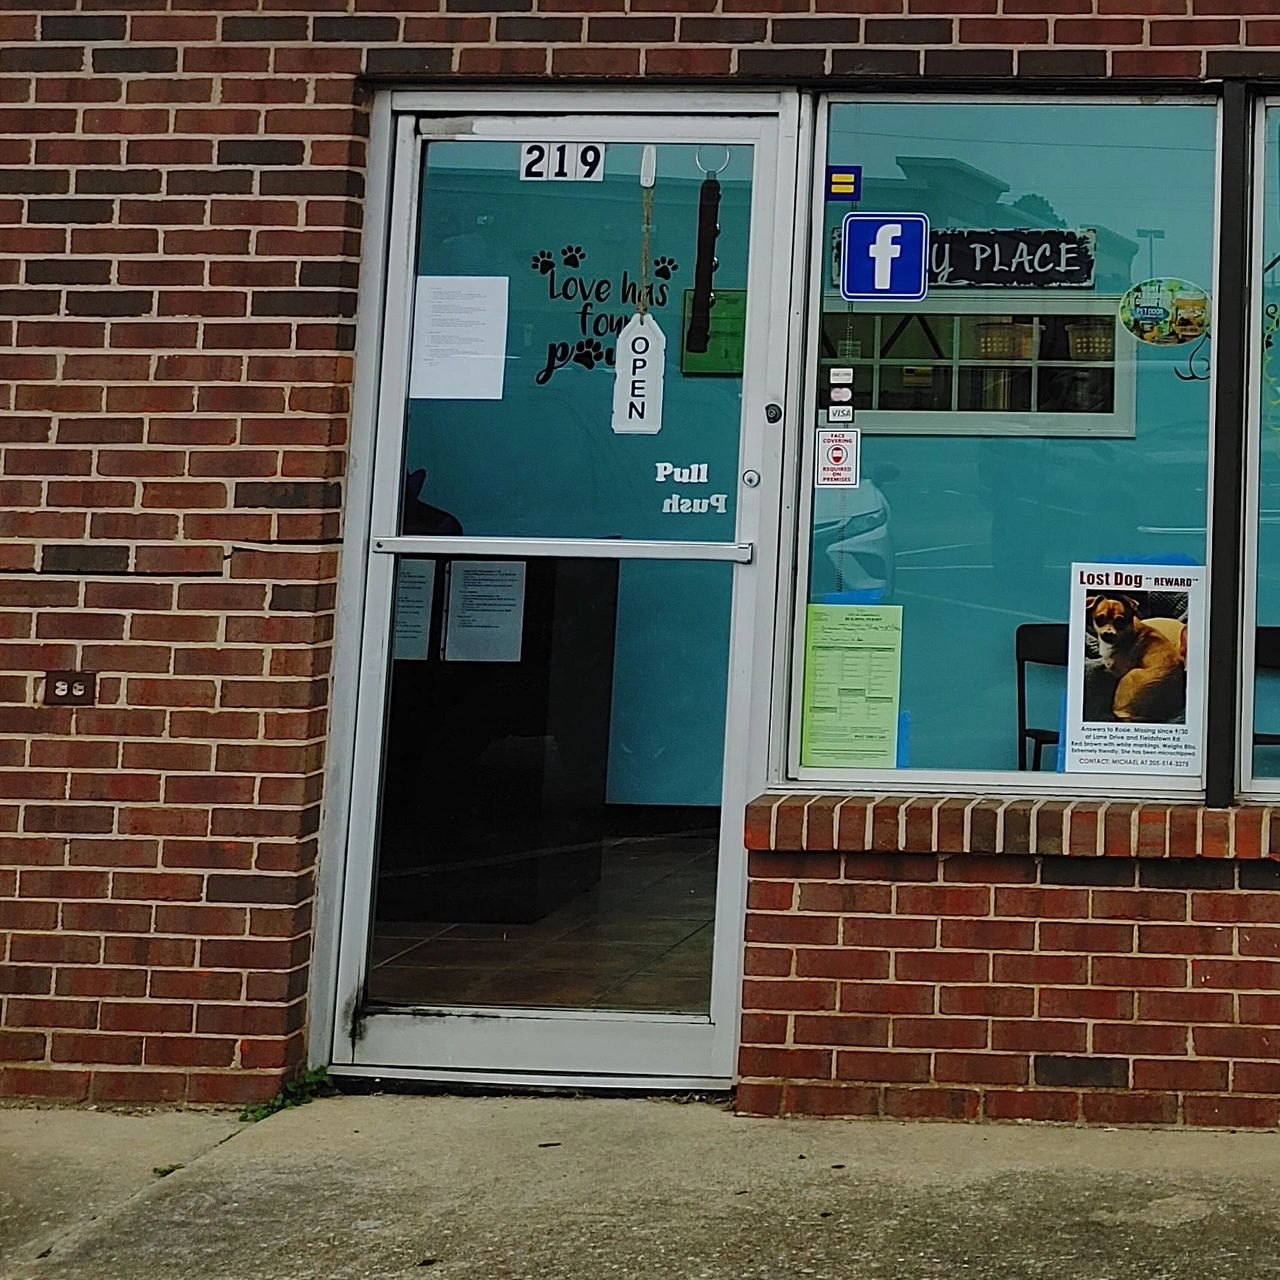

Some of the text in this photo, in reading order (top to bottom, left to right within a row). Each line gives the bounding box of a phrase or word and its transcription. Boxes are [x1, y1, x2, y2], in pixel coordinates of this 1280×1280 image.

[524, 144, 600, 178] 219
[869, 224, 901, 289] f
[970, 243, 1081, 273] PLACE
[550, 269, 611, 302] Love
[575, 303, 632, 338] fou
[628, 337, 650, 419] OPEN
[832, 410, 851, 418] VISA
[655, 462, 708, 483] Pull
[1080, 571, 1110, 586] Lost
[1114, 572, 1143, 588] Dog
